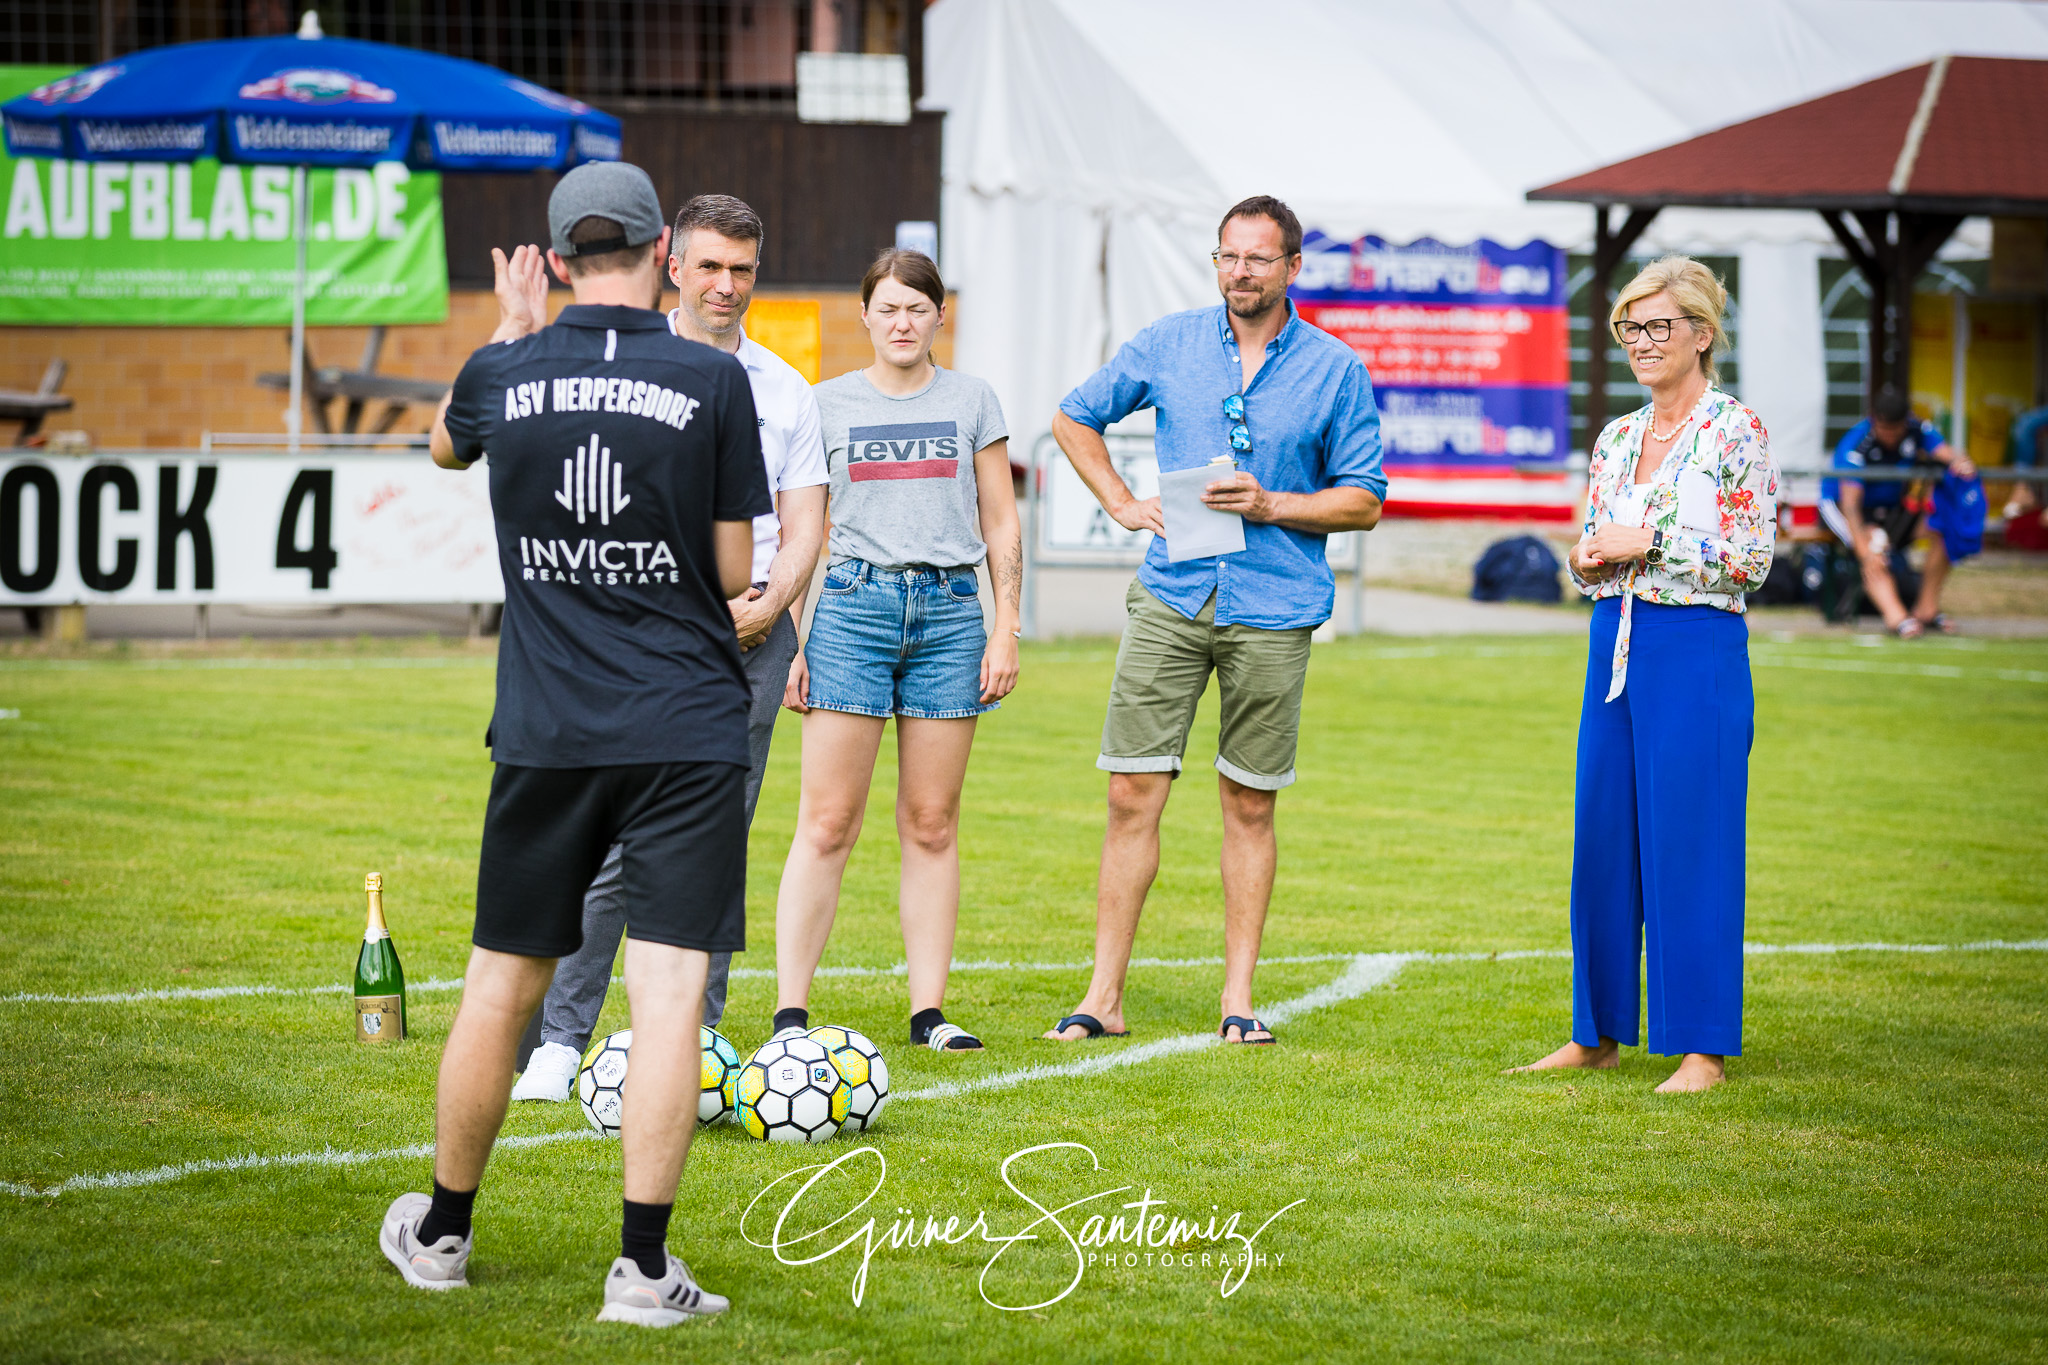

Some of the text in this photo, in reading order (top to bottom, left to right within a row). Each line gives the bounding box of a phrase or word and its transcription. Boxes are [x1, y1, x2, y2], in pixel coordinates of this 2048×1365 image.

[505, 377, 700, 431] ASV HERPERSDORF
[0, 464, 338, 593] OCK 4
[520, 536, 678, 571] INVICTA
[523, 567, 680, 586] REAL ESTATE
